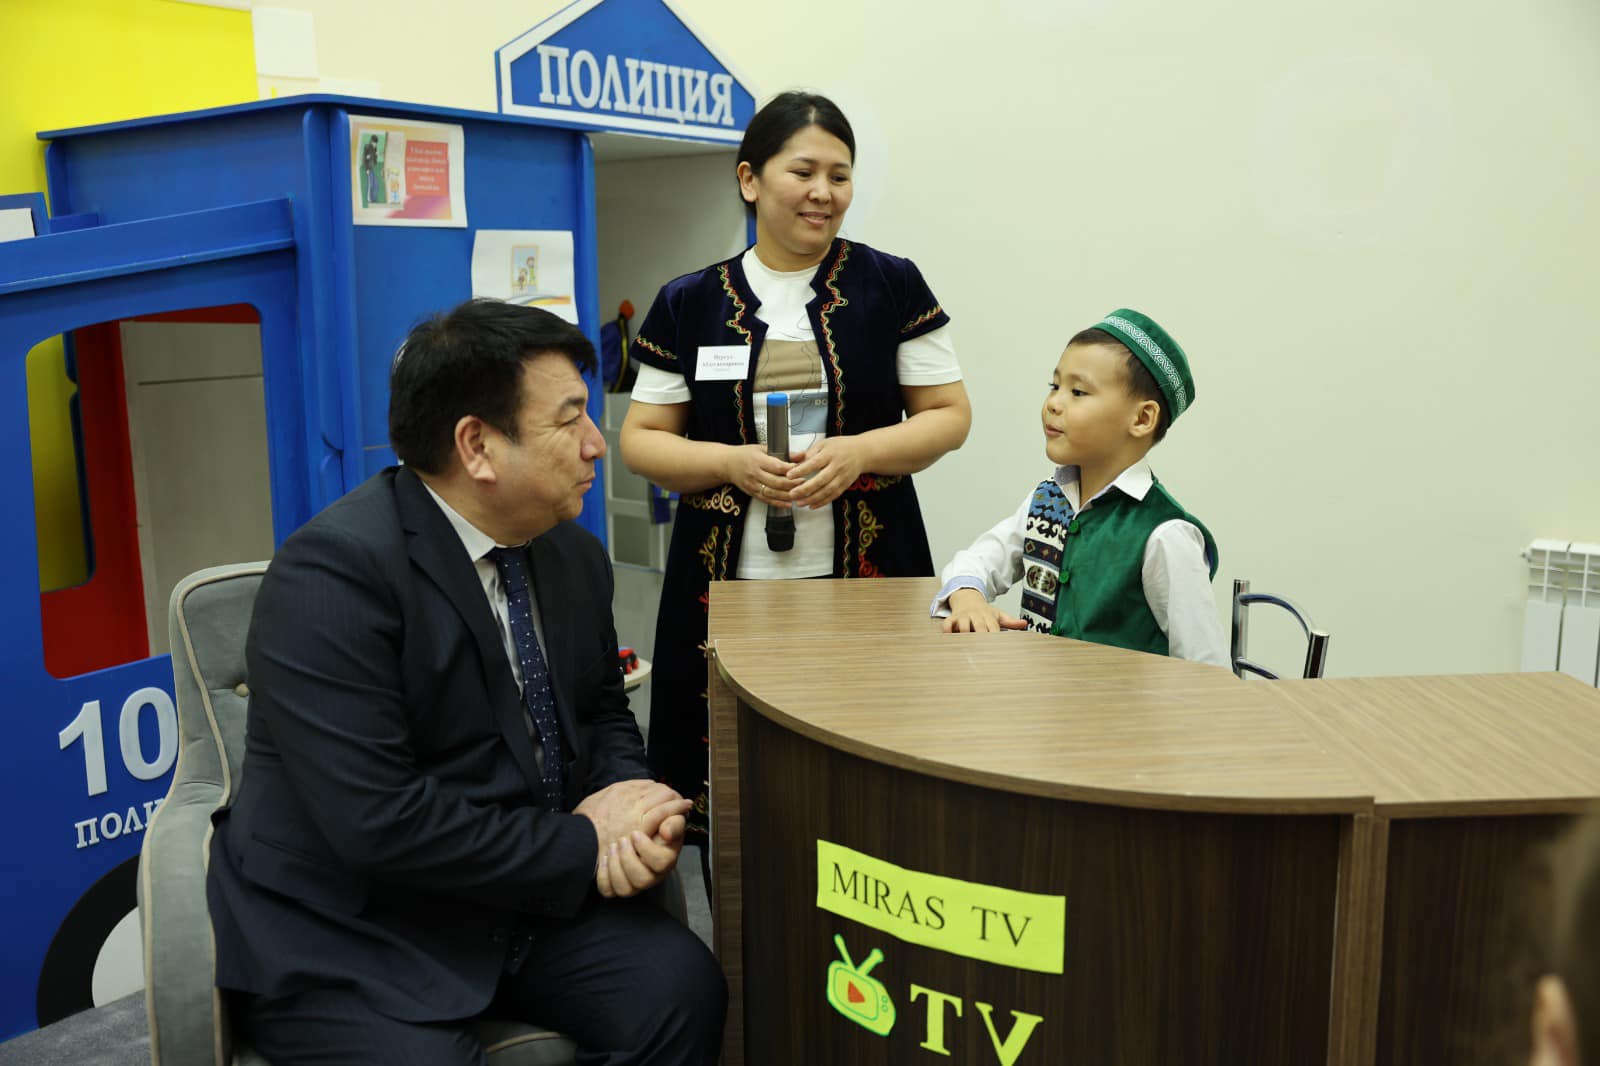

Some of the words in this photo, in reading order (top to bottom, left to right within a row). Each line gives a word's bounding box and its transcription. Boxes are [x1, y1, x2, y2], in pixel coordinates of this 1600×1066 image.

[538, 46, 734, 126] ПОЛИЦИЯ
[832, 862, 945, 930] MIRAS
[971, 906, 1032, 947] TV
[910, 983, 1044, 1066] TV
